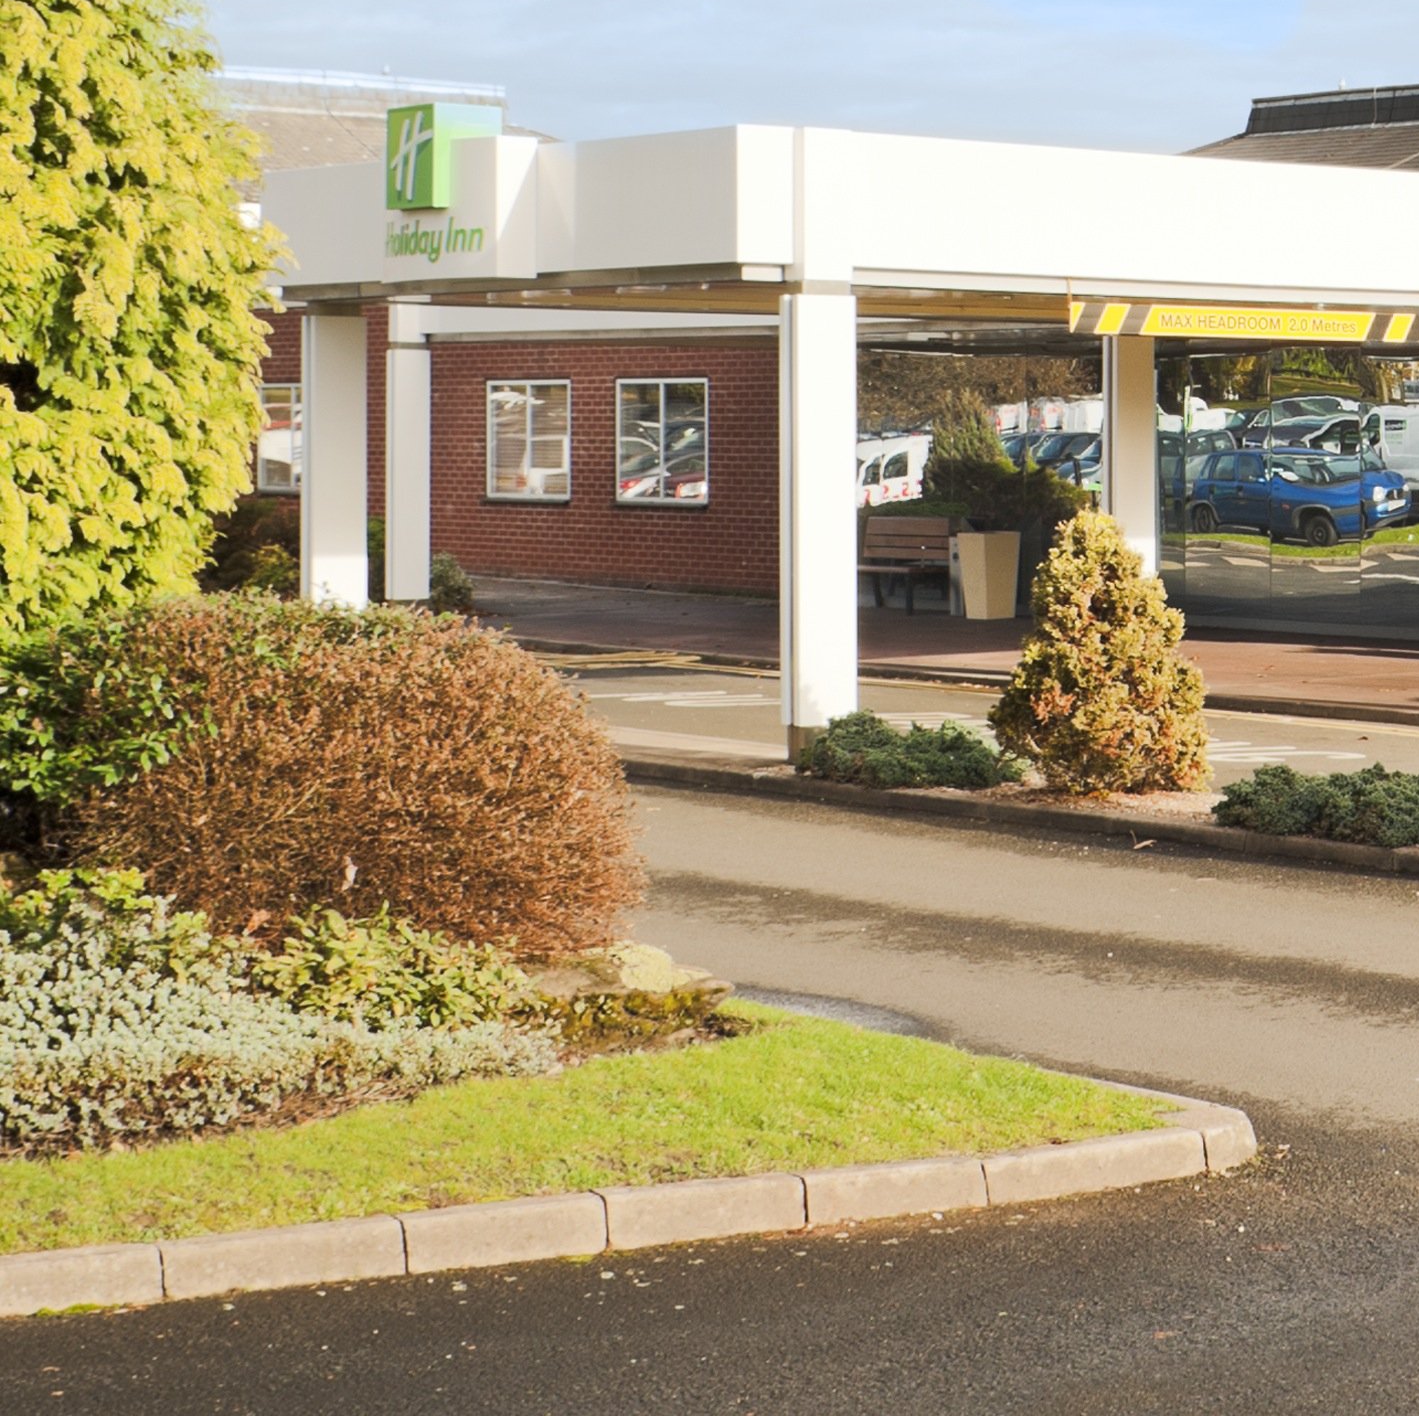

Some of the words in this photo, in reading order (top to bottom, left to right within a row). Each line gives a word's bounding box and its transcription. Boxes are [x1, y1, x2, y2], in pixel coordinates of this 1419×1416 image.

[384, 218, 443, 264] Holiday
[444, 215, 484, 253] Inn
[1160, 314, 1193, 329] MAX
[1197, 315, 1281, 331] HEADROOM
[1288, 318, 1308, 332] 2.0
[1311, 319, 1357, 334] Metres
